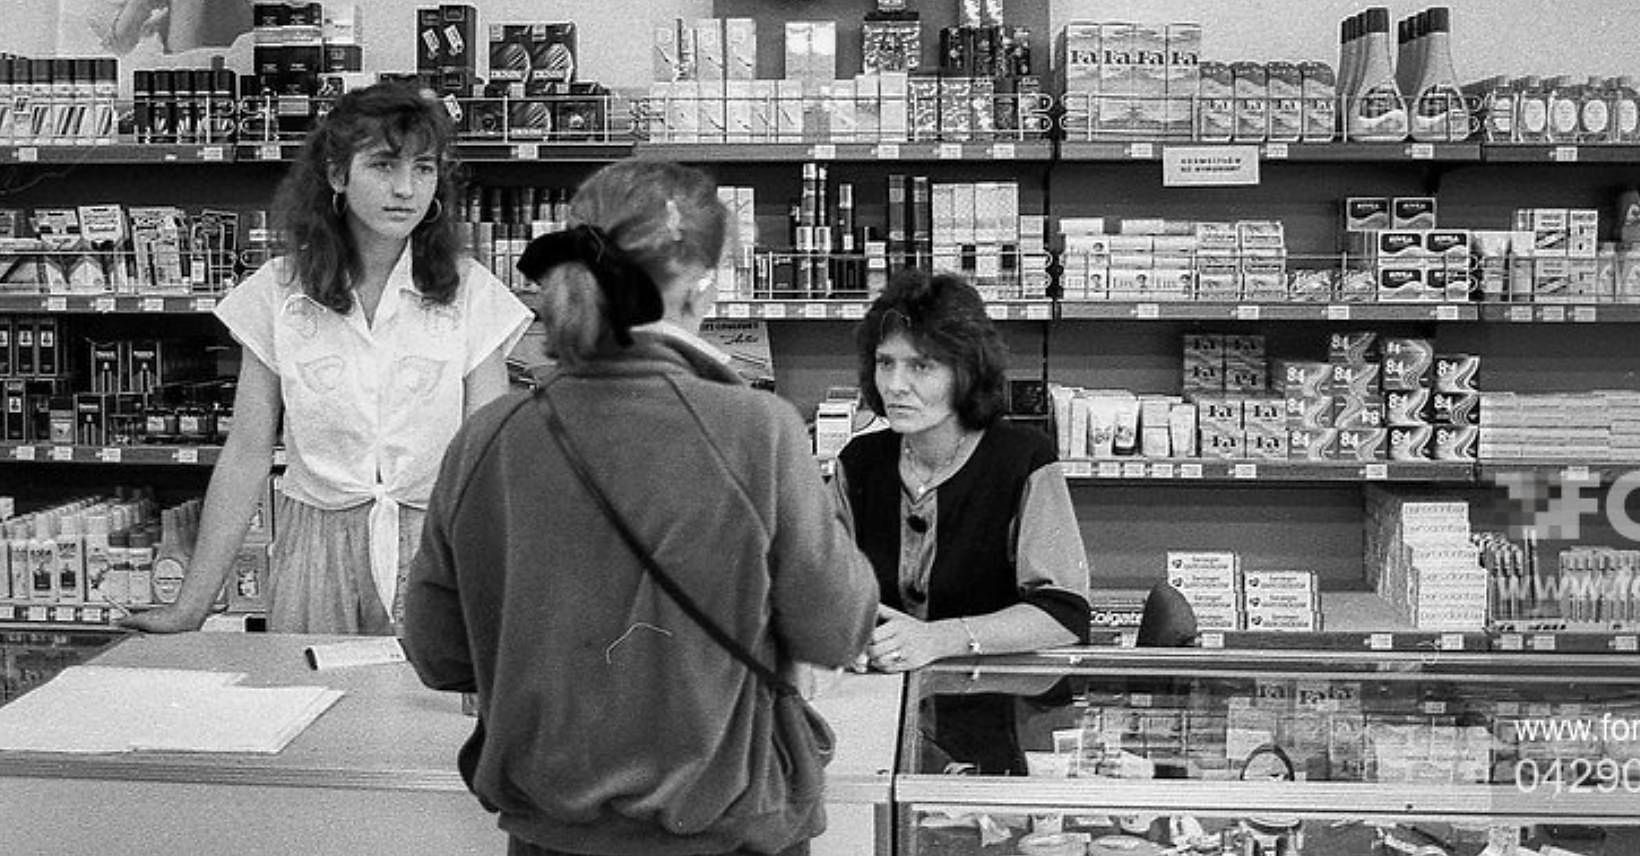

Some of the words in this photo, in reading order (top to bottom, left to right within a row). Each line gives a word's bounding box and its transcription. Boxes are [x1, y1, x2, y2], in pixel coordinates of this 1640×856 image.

[1071, 50, 1096, 63] Fa
[1104, 50, 1130, 65] Fa
[1138, 52, 1164, 65] Fa
[1172, 52, 1197, 65] Fa
[1331, 334, 1349, 350] 84
[1286, 366, 1304, 383] 84
[1334, 366, 1352, 382] 84
[1385, 359, 1404, 375] 84
[1437, 359, 1457, 376] 84
[1389, 393, 1408, 409] 84
[1434, 393, 1452, 411] 84
[1291, 429, 1310, 447] 84
[1340, 430, 1359, 447] 84
[1391, 429, 1411, 445] 84
[1436, 429, 1456, 445] 84
